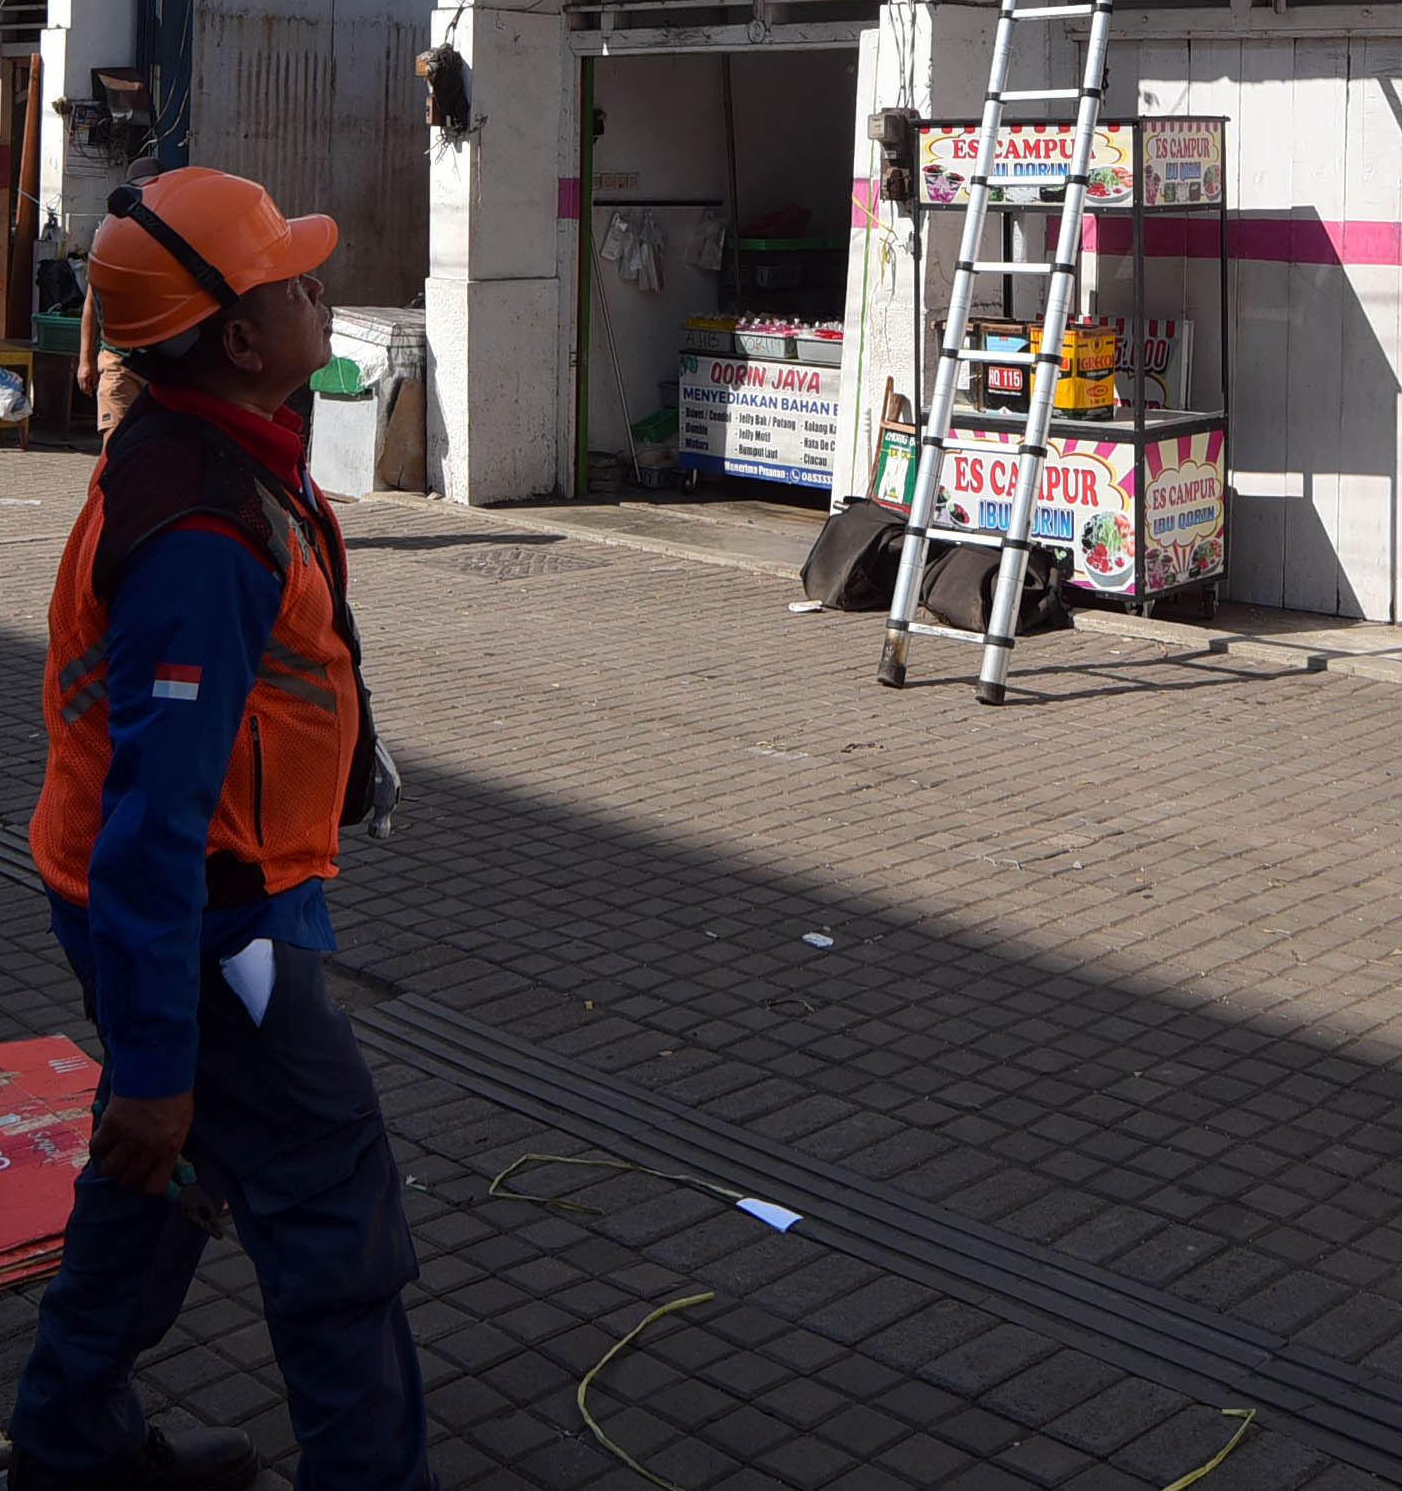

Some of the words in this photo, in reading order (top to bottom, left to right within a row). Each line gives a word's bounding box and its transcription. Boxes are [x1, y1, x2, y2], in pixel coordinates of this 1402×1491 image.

[952, 138, 980, 160] ES
[993, 138, 1096, 160] CAMPU
[1155, 137, 1168, 159] ES
[1170, 137, 1210, 159] CAMPUR
[1114, 338, 1167, 368] 5.00
[710, 362, 767, 388] QORIN
[771, 368, 821, 395] JAYA
[1002, 369, 1021, 389] 115
[683, 387, 778, 410] MENYEDIAKAN
[781, 397, 830, 416] BAHAN
[804, 437, 819, 450] Nata
[820, 439, 829, 451] De
[954, 456, 984, 494] ES
[1152, 487, 1167, 511] ES
[1168, 477, 1216, 507] CAMPUR
[979, 499, 1013, 532] IBU
[1153, 514, 1175, 535] IBU
[1178, 505, 1215, 530] QORIN
